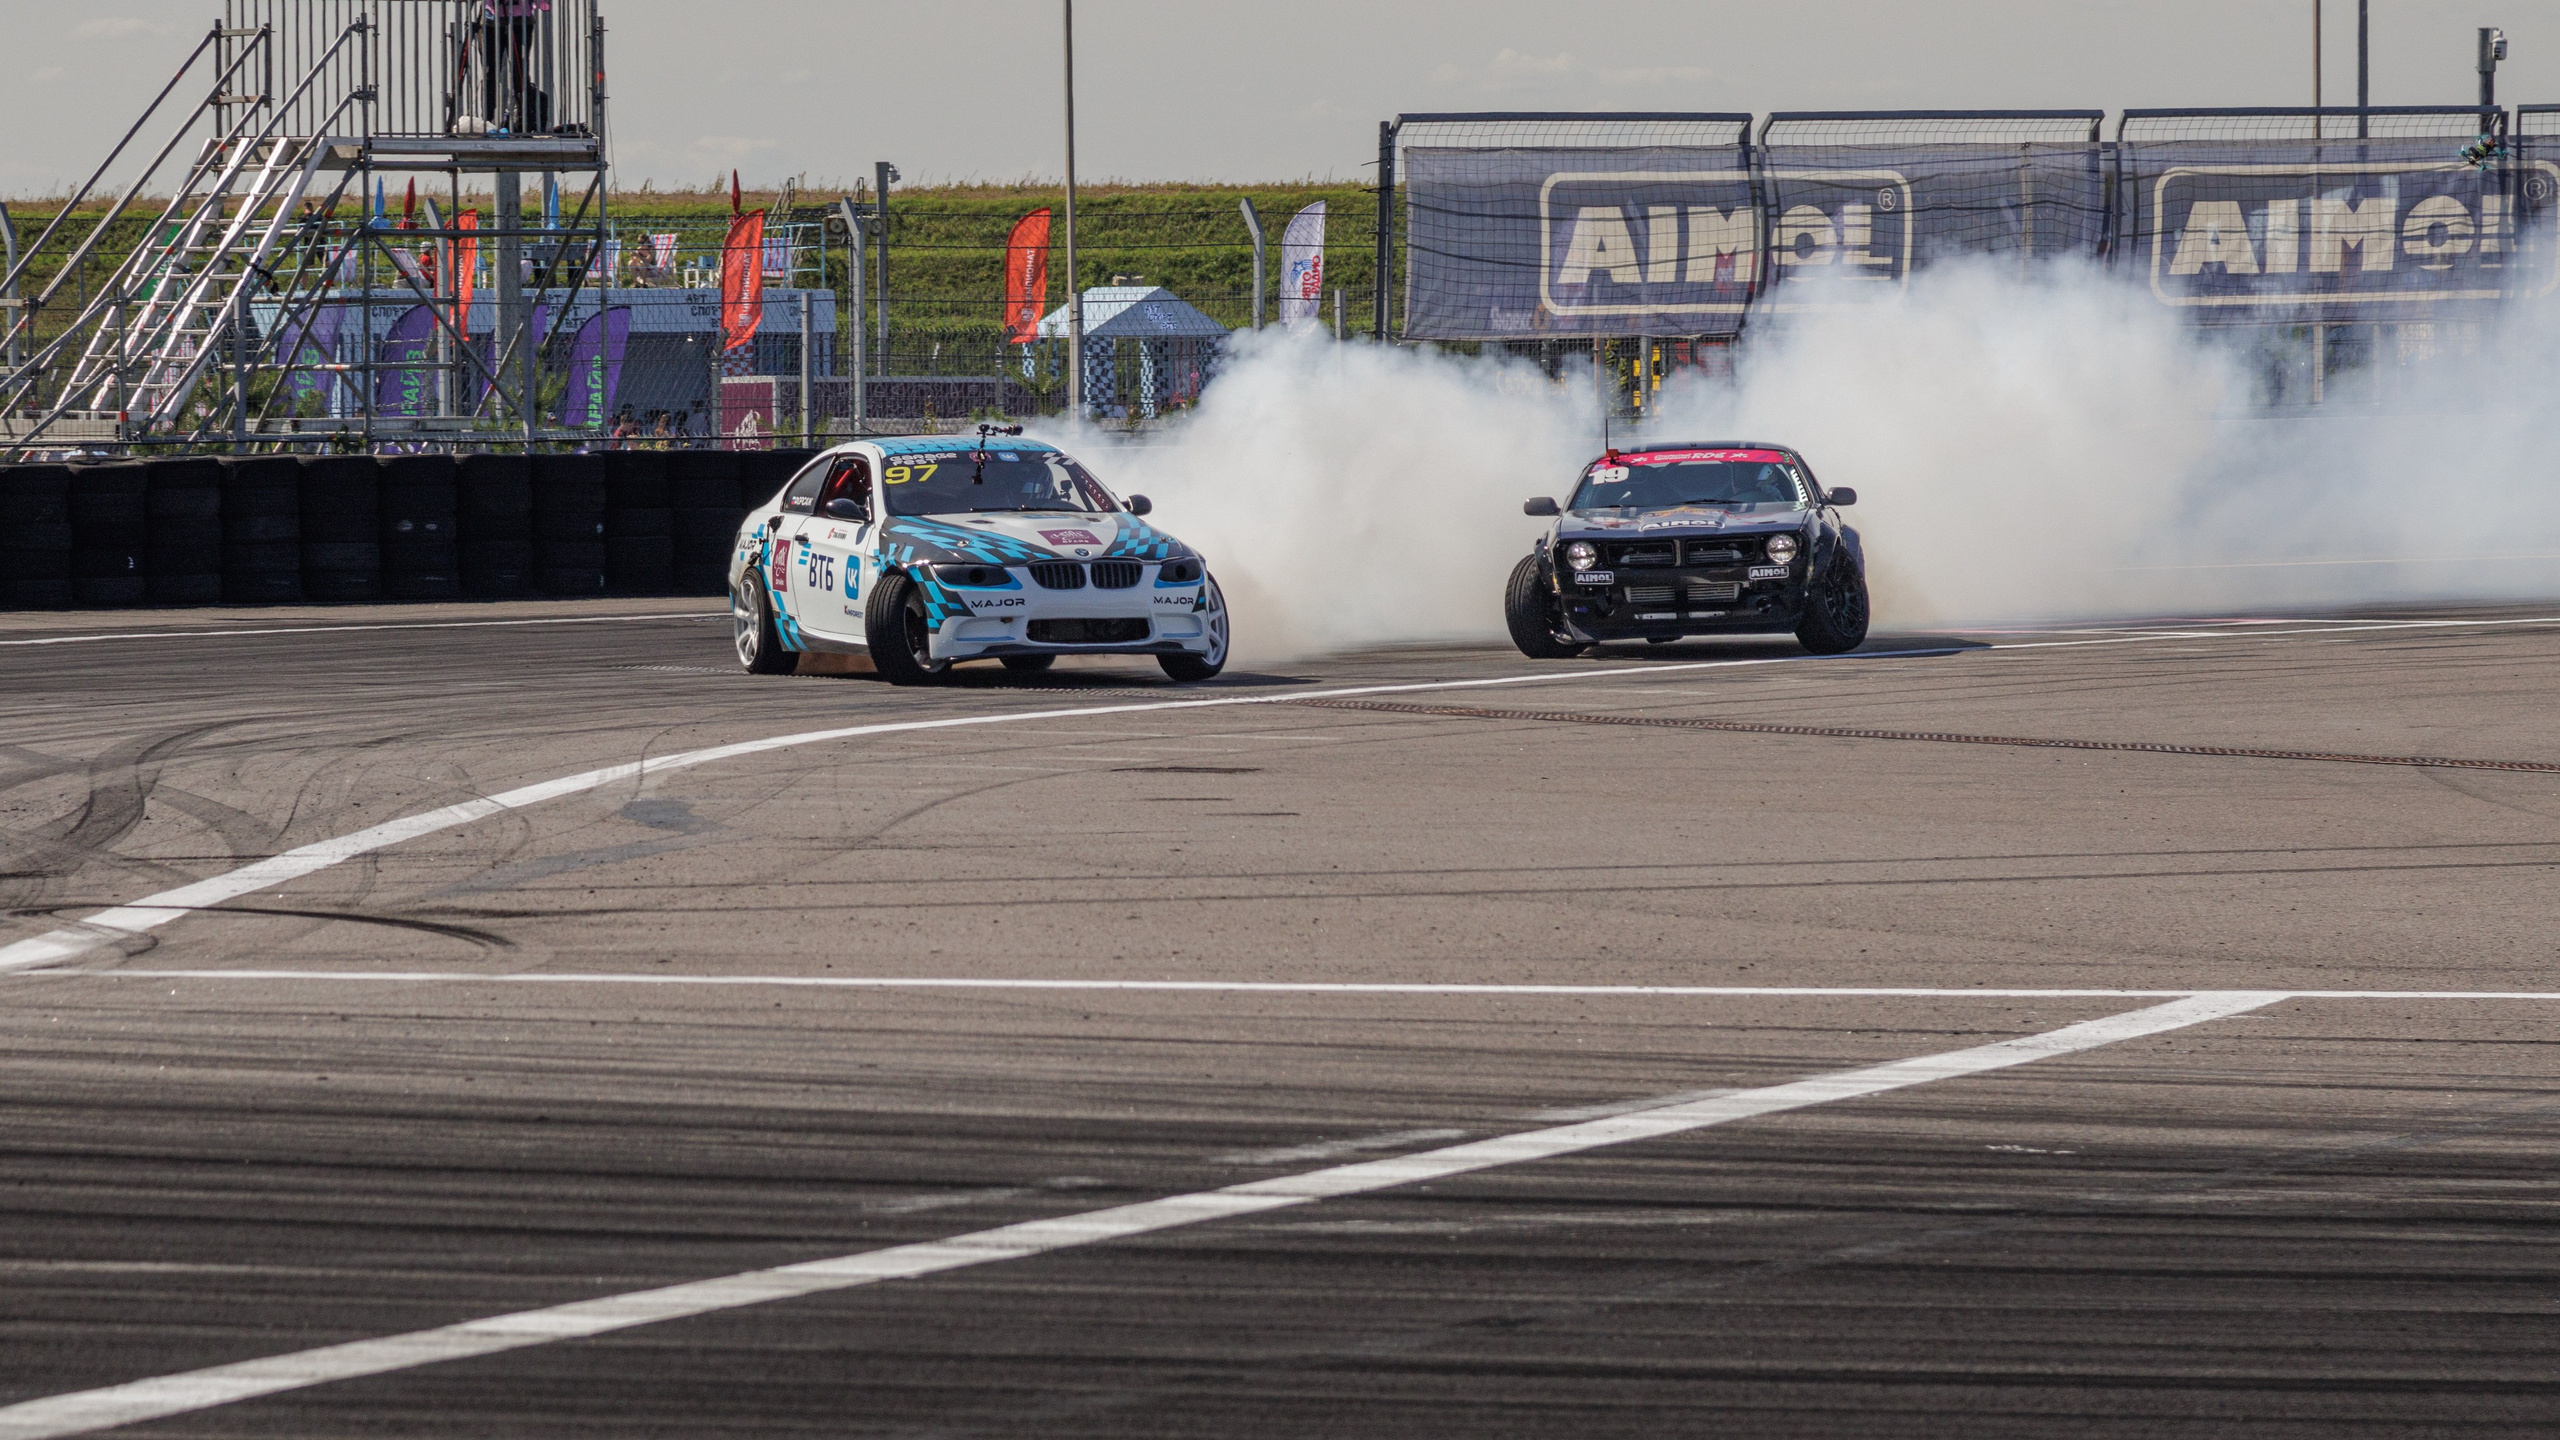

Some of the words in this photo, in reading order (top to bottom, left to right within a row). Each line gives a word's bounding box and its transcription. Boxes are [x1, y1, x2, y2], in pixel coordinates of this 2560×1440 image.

[2169, 194, 2535, 275] AIMOL
[1557, 204, 1893, 283] AIMOL
[1311, 255, 1321, 295] РАДИО
[685, 293, 708, 304] АРТ
[691, 305, 723, 317] СПОР
[885, 464, 938, 485] 97
[1588, 466, 1630, 485] 19
[809, 552, 834, 592] ВТБ
[1577, 573, 1612, 583] AIMOL
[1751, 567, 1787, 578] AIMOL
[970, 598, 1026, 609] MAJOR
[1153, 596, 1194, 605] MAJOR
